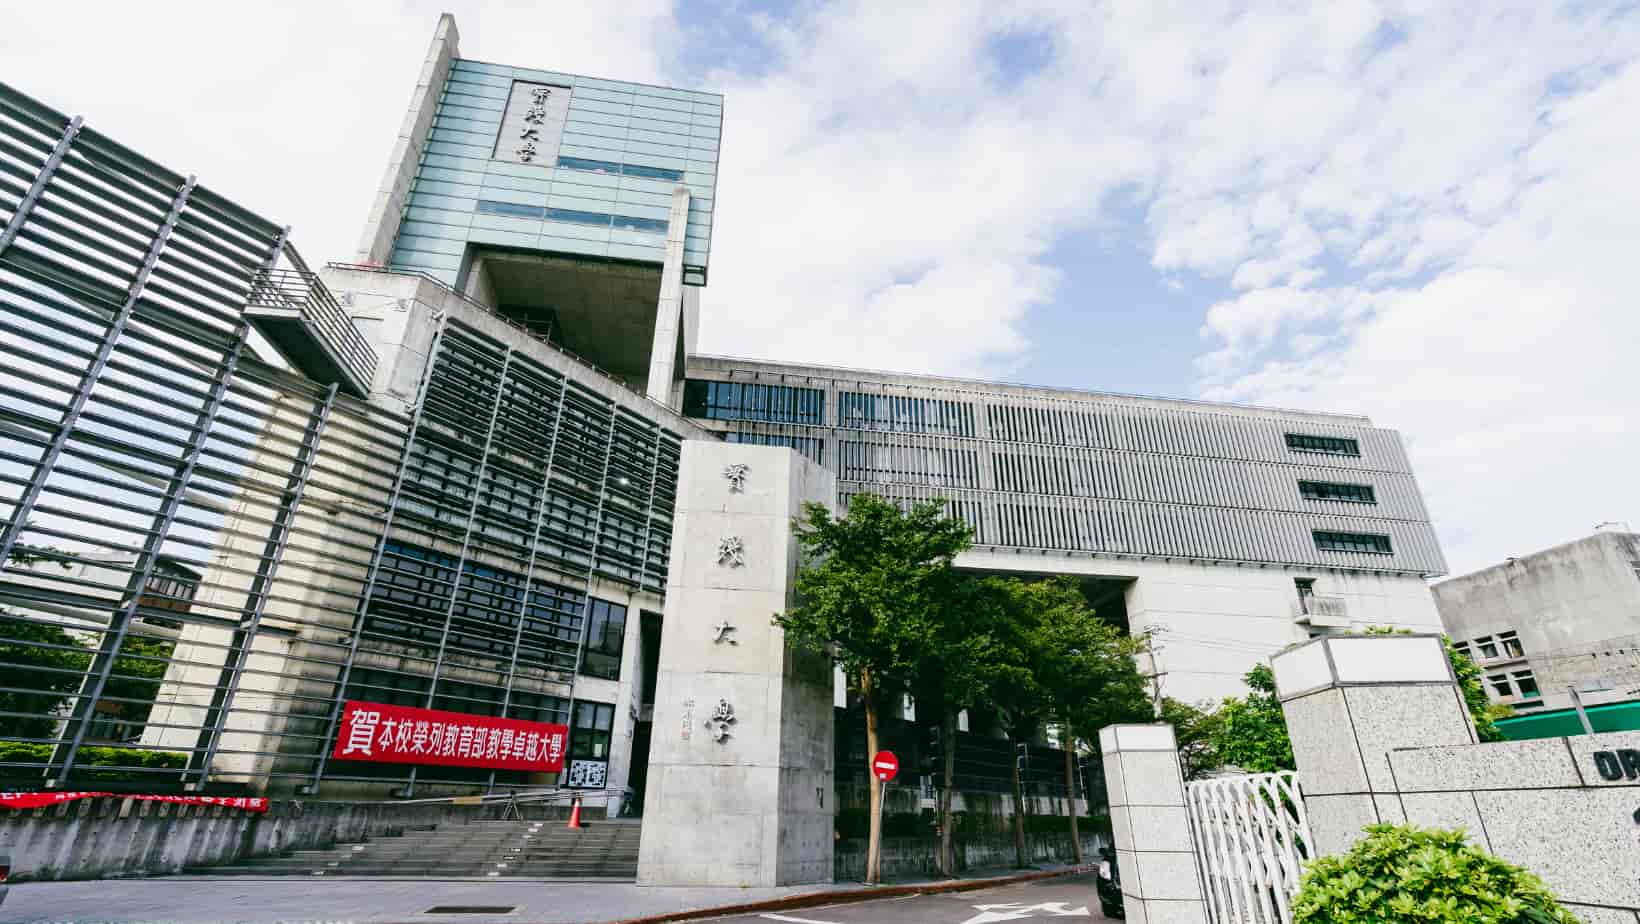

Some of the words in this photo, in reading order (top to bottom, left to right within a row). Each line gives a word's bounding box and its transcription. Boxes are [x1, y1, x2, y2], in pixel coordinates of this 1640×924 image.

[342, 708, 563, 764] 賀本校榮列教育部教學卓越大學
